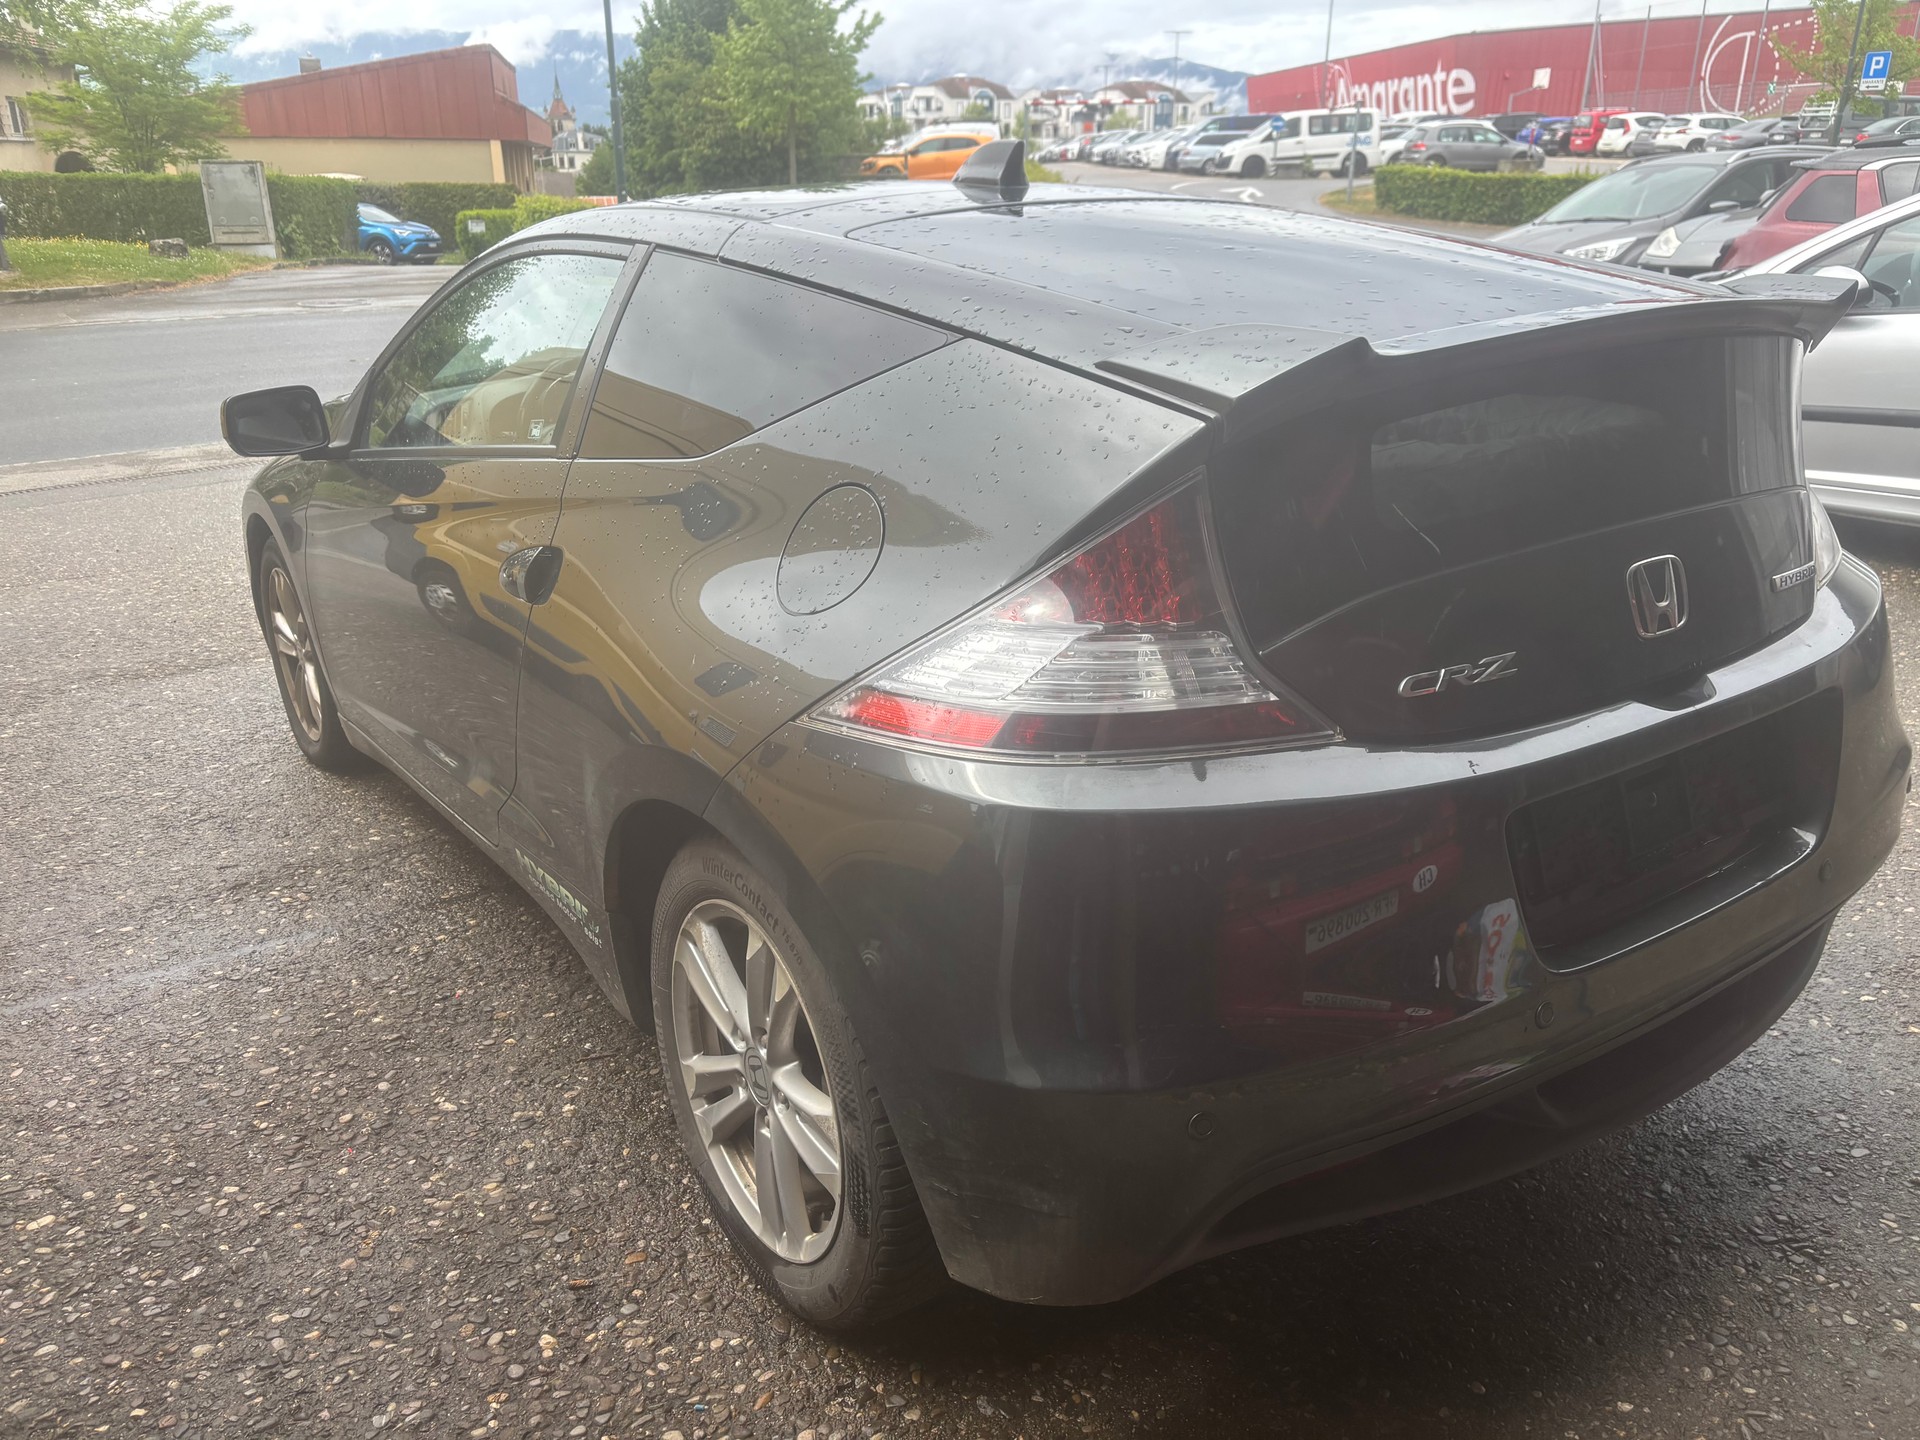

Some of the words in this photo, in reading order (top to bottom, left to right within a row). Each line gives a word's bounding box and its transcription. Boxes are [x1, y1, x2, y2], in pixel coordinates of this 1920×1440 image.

[1869, 56, 1884, 77] P
[1336, 58, 1477, 116] Amarante
[1780, 565, 1816, 587] HYBRID
[702, 856, 779, 933] WinterContact
